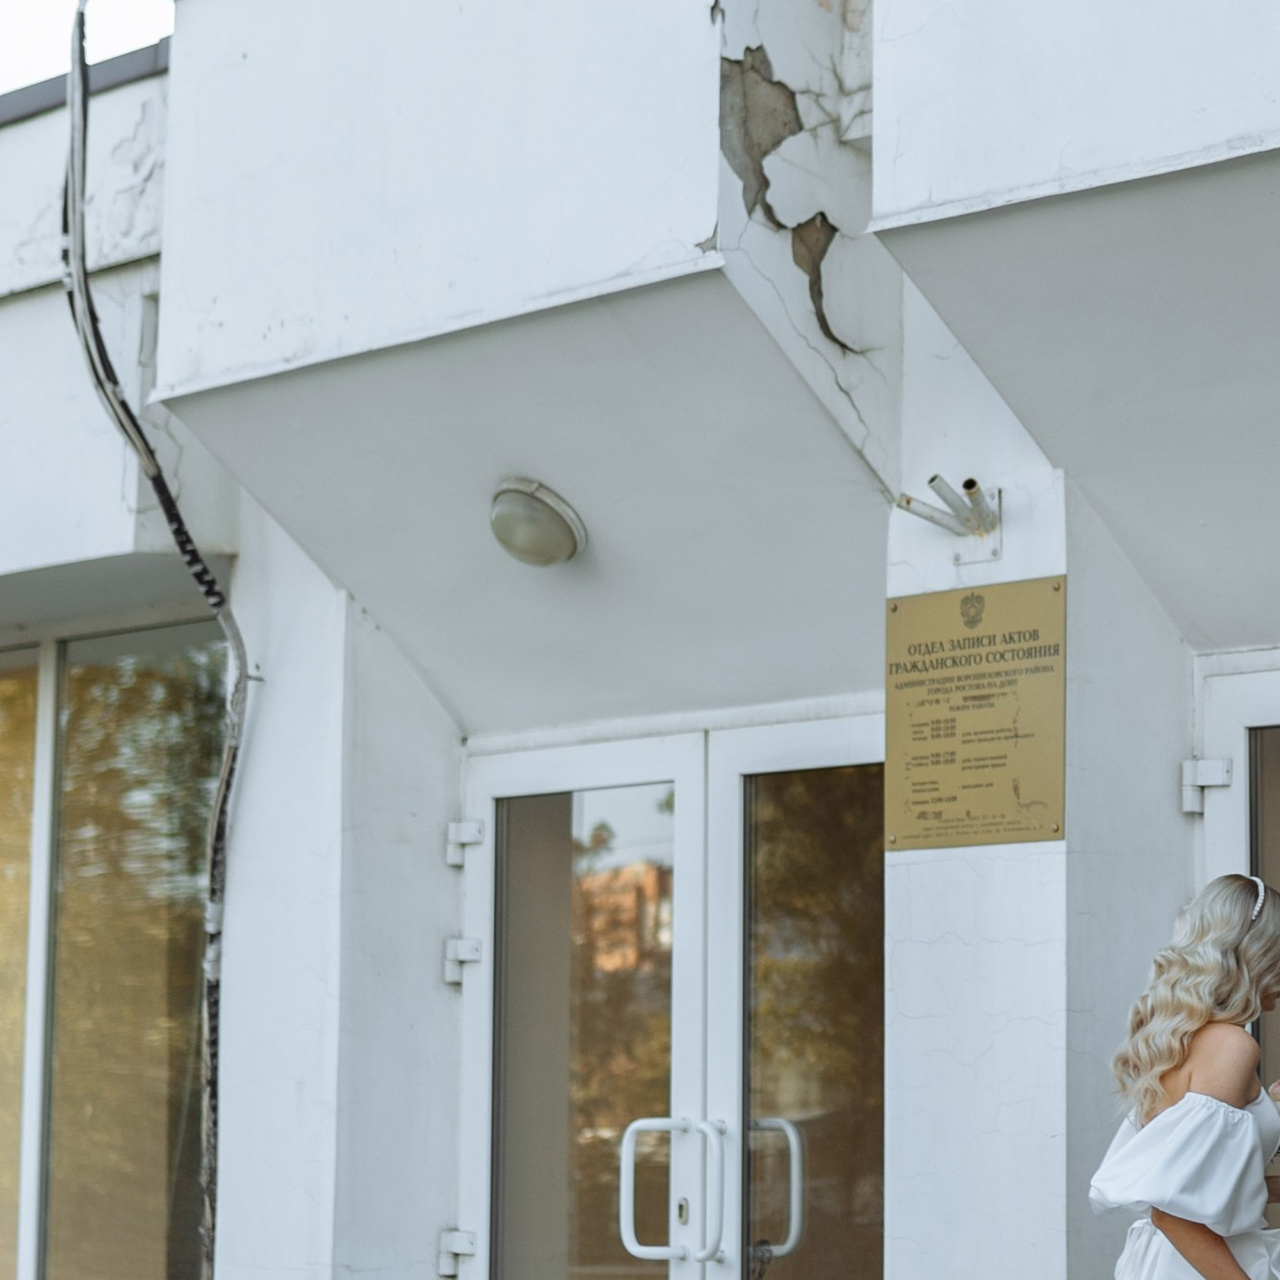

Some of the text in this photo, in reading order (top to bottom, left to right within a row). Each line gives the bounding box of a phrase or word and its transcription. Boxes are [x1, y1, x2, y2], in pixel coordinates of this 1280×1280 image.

[907, 629, 1040, 657] ОТДЕЛ ЗАПИСИ АКТОВ
[889, 643, 1060, 676] ГРАЖДАНСКОГО СОСТОЯНИЯ
